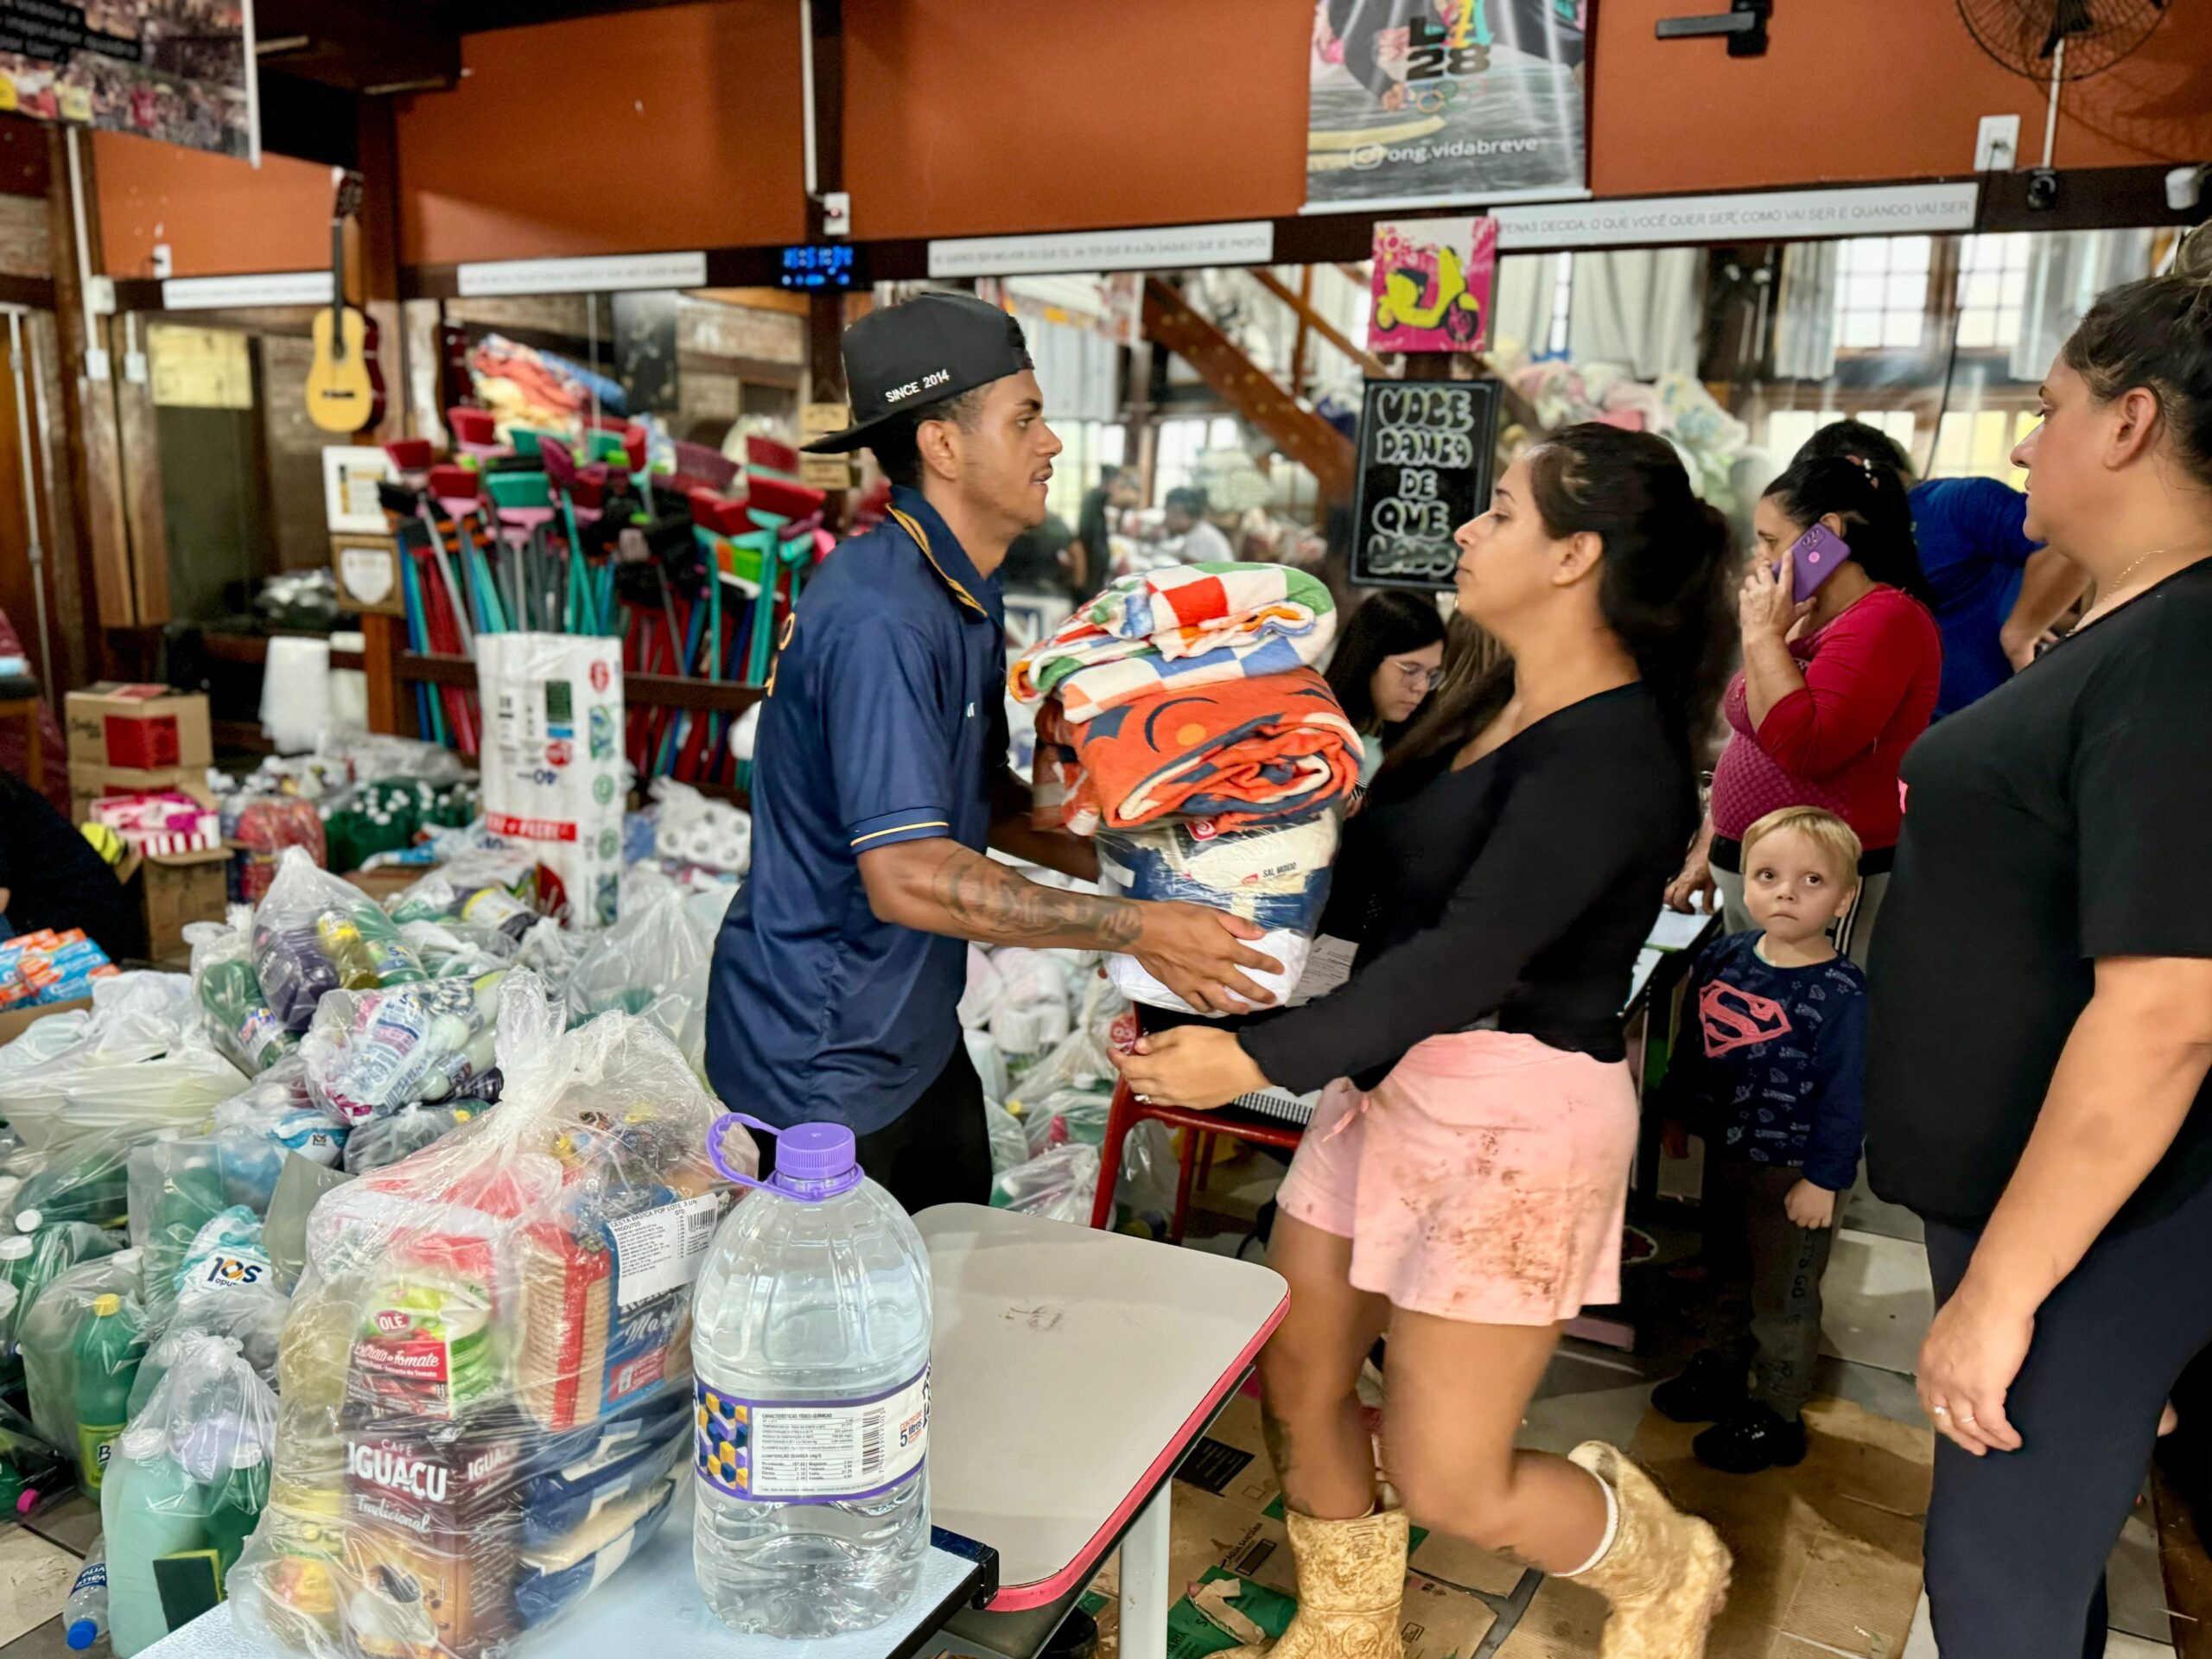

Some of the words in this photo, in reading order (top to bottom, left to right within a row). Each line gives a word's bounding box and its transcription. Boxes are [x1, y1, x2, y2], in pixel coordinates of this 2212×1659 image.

[1407, 44, 1491, 80] 28
[1388, 137, 1539, 162] ong.vidabreve
[1497, 221, 1538, 234] PENAS
[885, 381, 921, 403] SINCE
[922, 368, 950, 389] 2014
[394, 1350, 440, 1368] Tomate
[899, 1428, 908, 1447] 5
